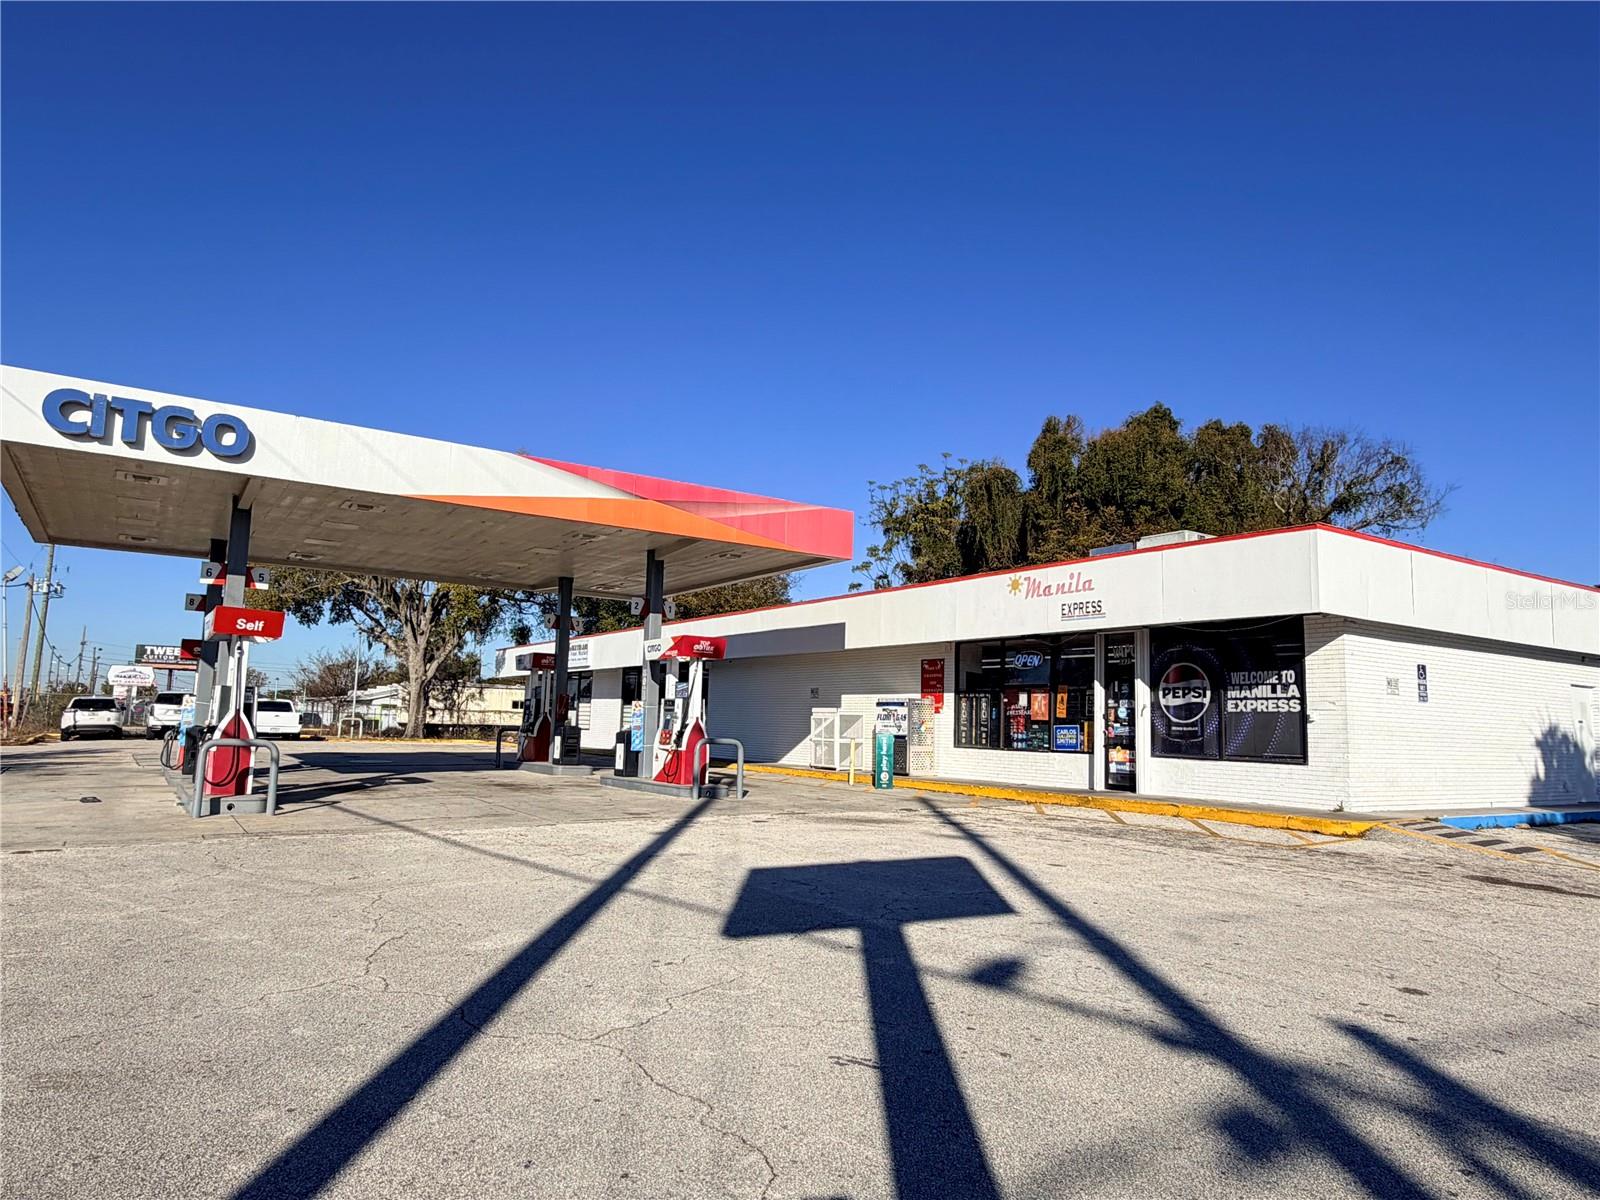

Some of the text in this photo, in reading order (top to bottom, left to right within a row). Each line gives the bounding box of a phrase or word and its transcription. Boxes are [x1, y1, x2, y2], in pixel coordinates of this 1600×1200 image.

[42, 388, 251, 457] CITGO
[206, 567, 213, 577] 6
[258, 573, 265, 582] 5
[1024, 572, 1095, 599] Manila
[1061, 600, 1103, 616] EXPRESS
[236, 618, 264, 631] Self
[1014, 654, 1041, 667] OPEN
[1231, 670, 1296, 685] WELCOME TO
[1162, 686, 1207, 699] PEPSI
[1227, 684, 1301, 699] MANILLA
[1227, 699, 1301, 713] EXPRESS
